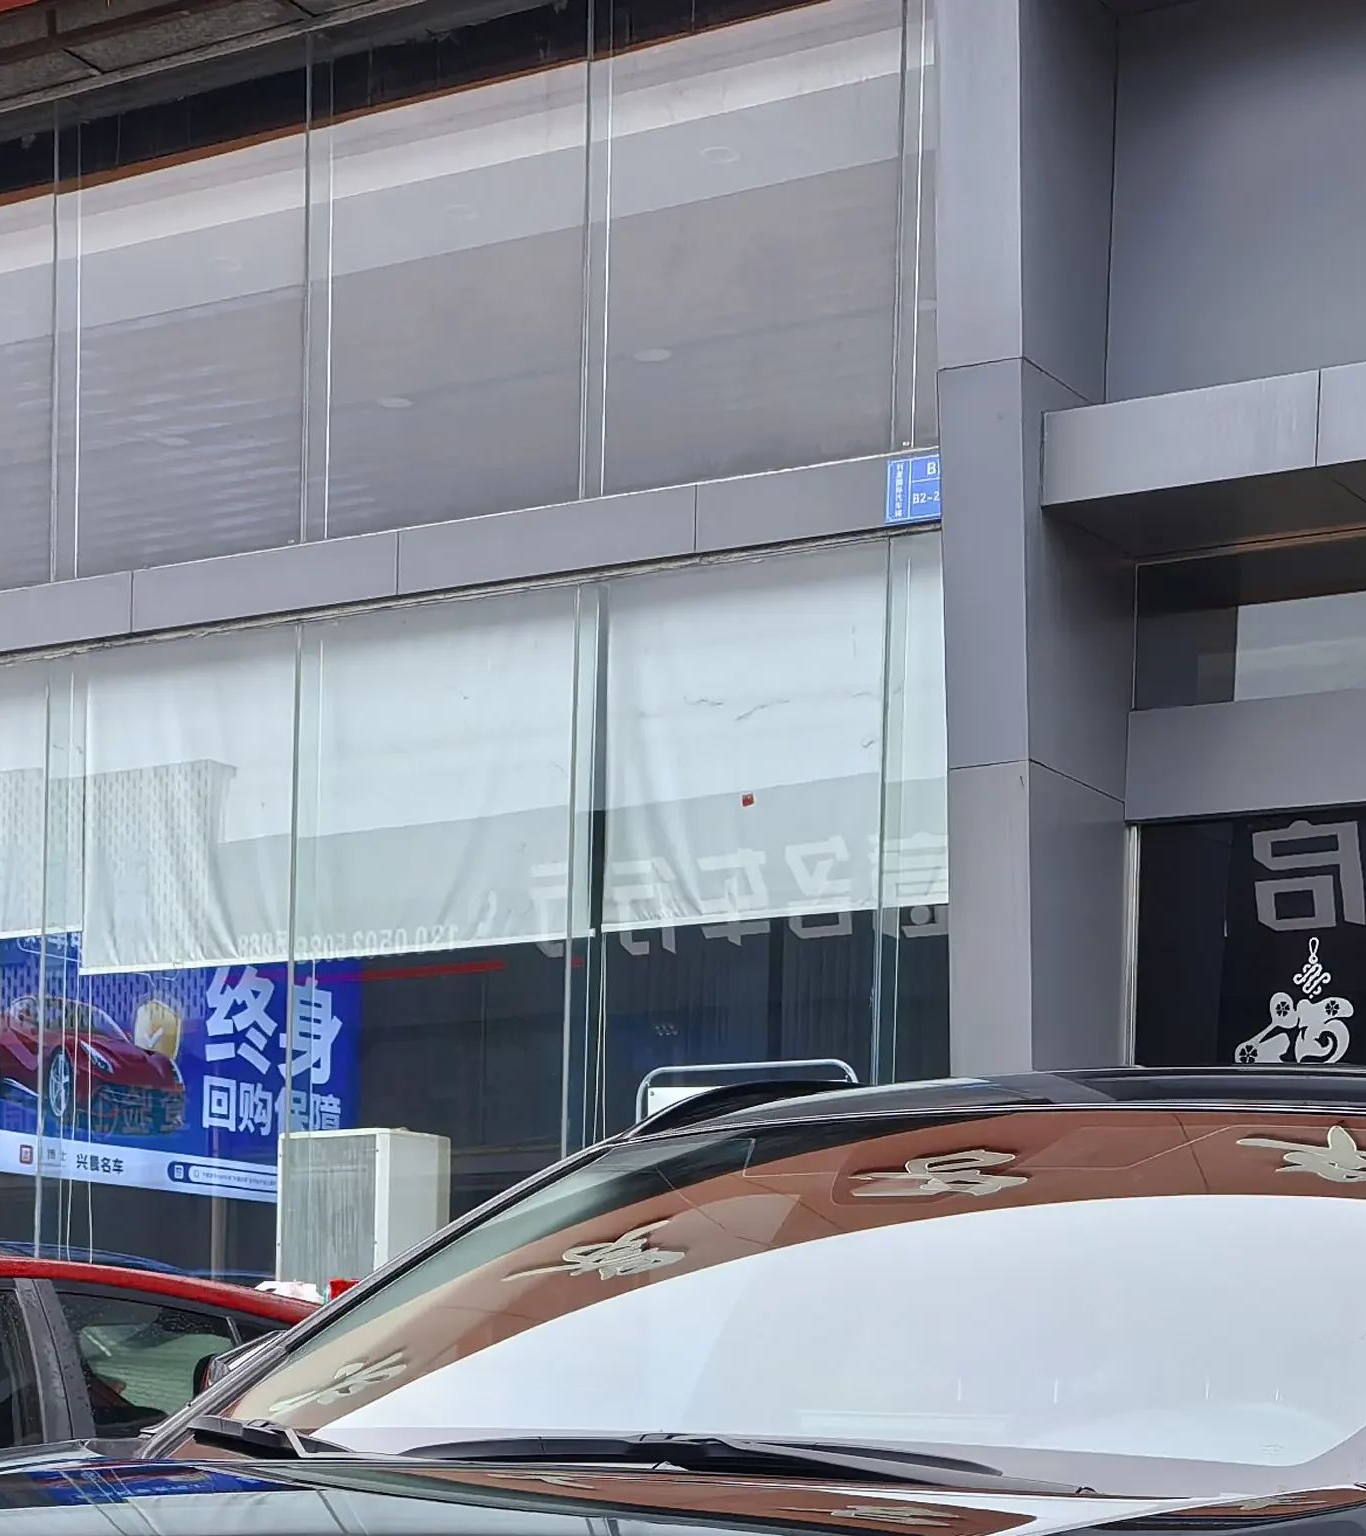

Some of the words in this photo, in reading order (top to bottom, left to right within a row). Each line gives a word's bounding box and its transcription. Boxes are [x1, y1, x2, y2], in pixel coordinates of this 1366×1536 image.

[205, 965, 342, 1084] 终身
[203, 1075, 341, 1136] 回购保障
[76, 1153, 124, 1175] 兴晨名车
